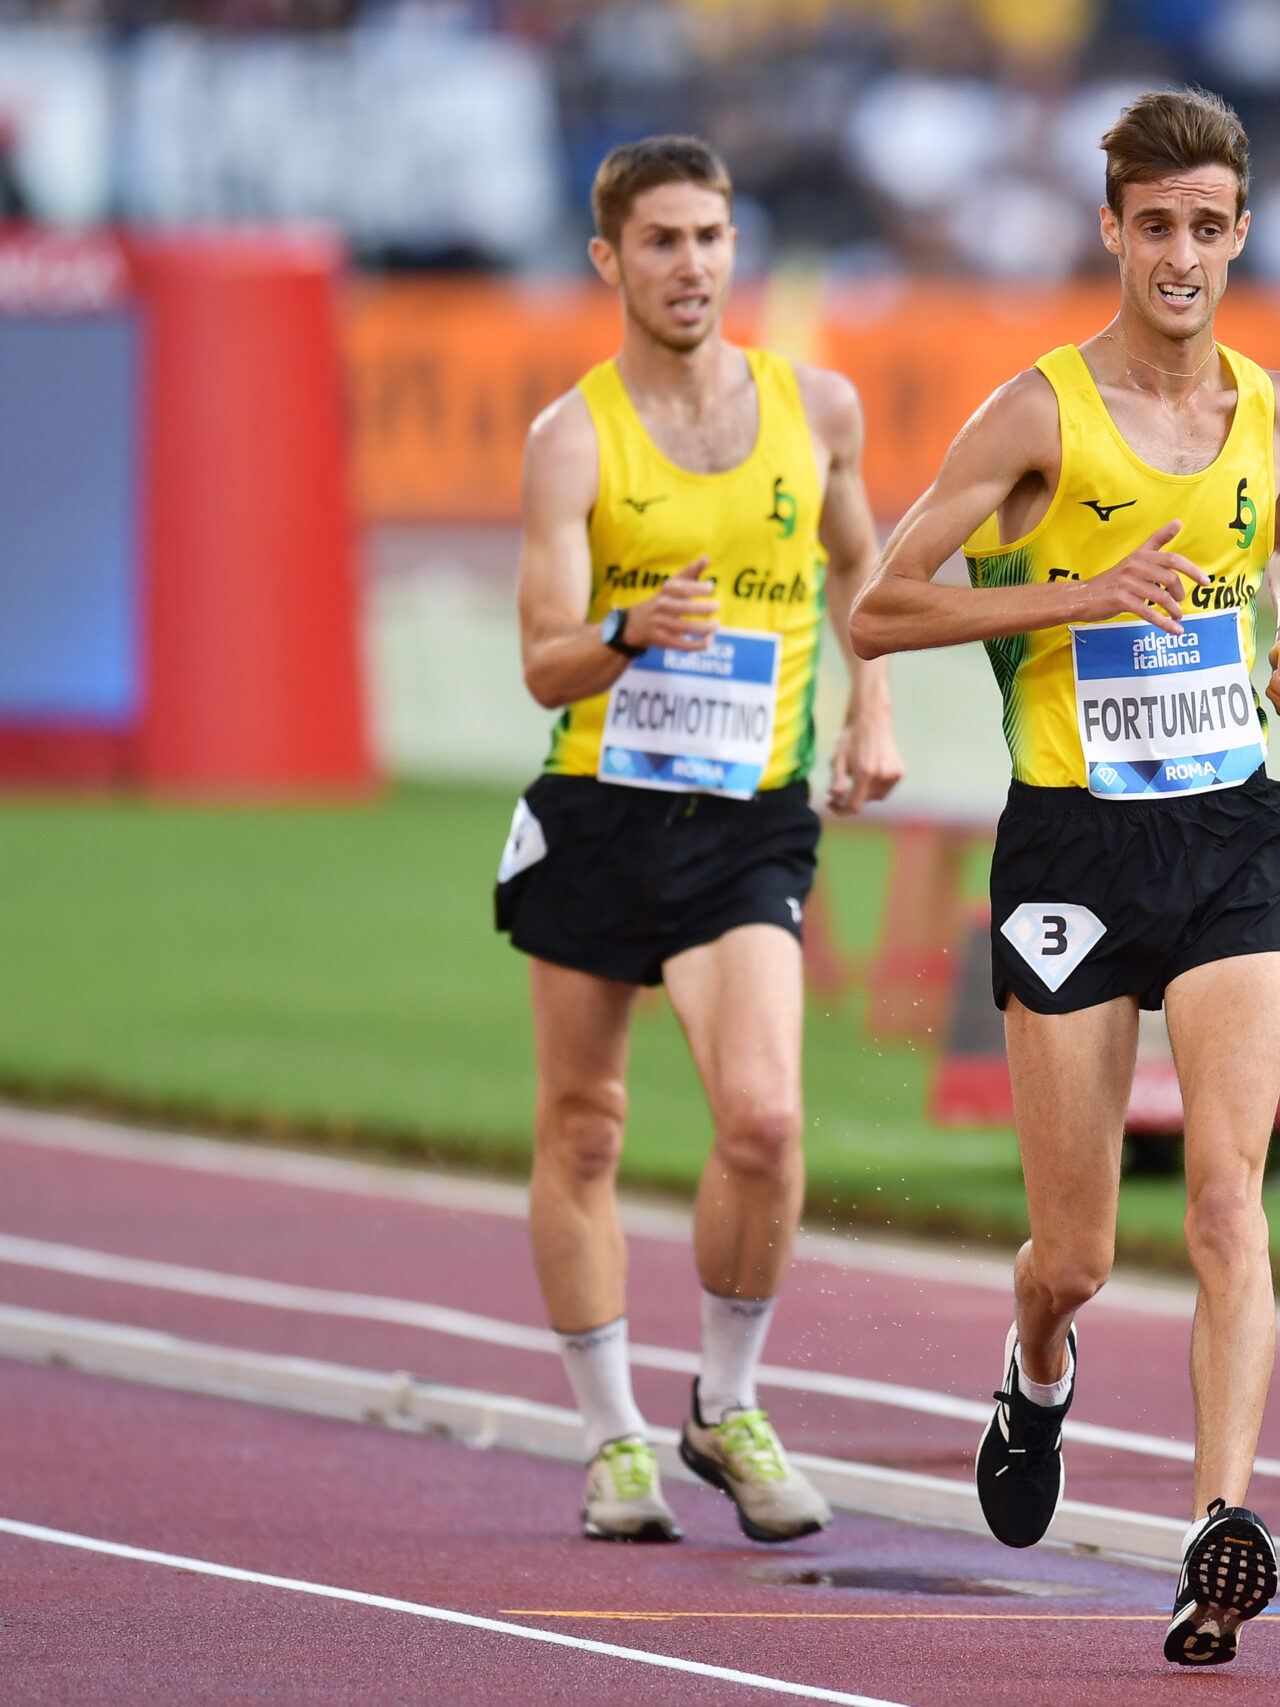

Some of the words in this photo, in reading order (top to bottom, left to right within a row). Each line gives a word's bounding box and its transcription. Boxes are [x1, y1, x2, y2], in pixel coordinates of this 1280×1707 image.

[1133, 631, 1199, 653] atletica
[1133, 649, 1200, 670] italiana
[612, 689, 767, 742] PICCHIOTTINO
[1083, 683, 1249, 742] FORTUNATO
[1165, 761, 1216, 781] ROMA
[1041, 915, 1068, 956] 3
